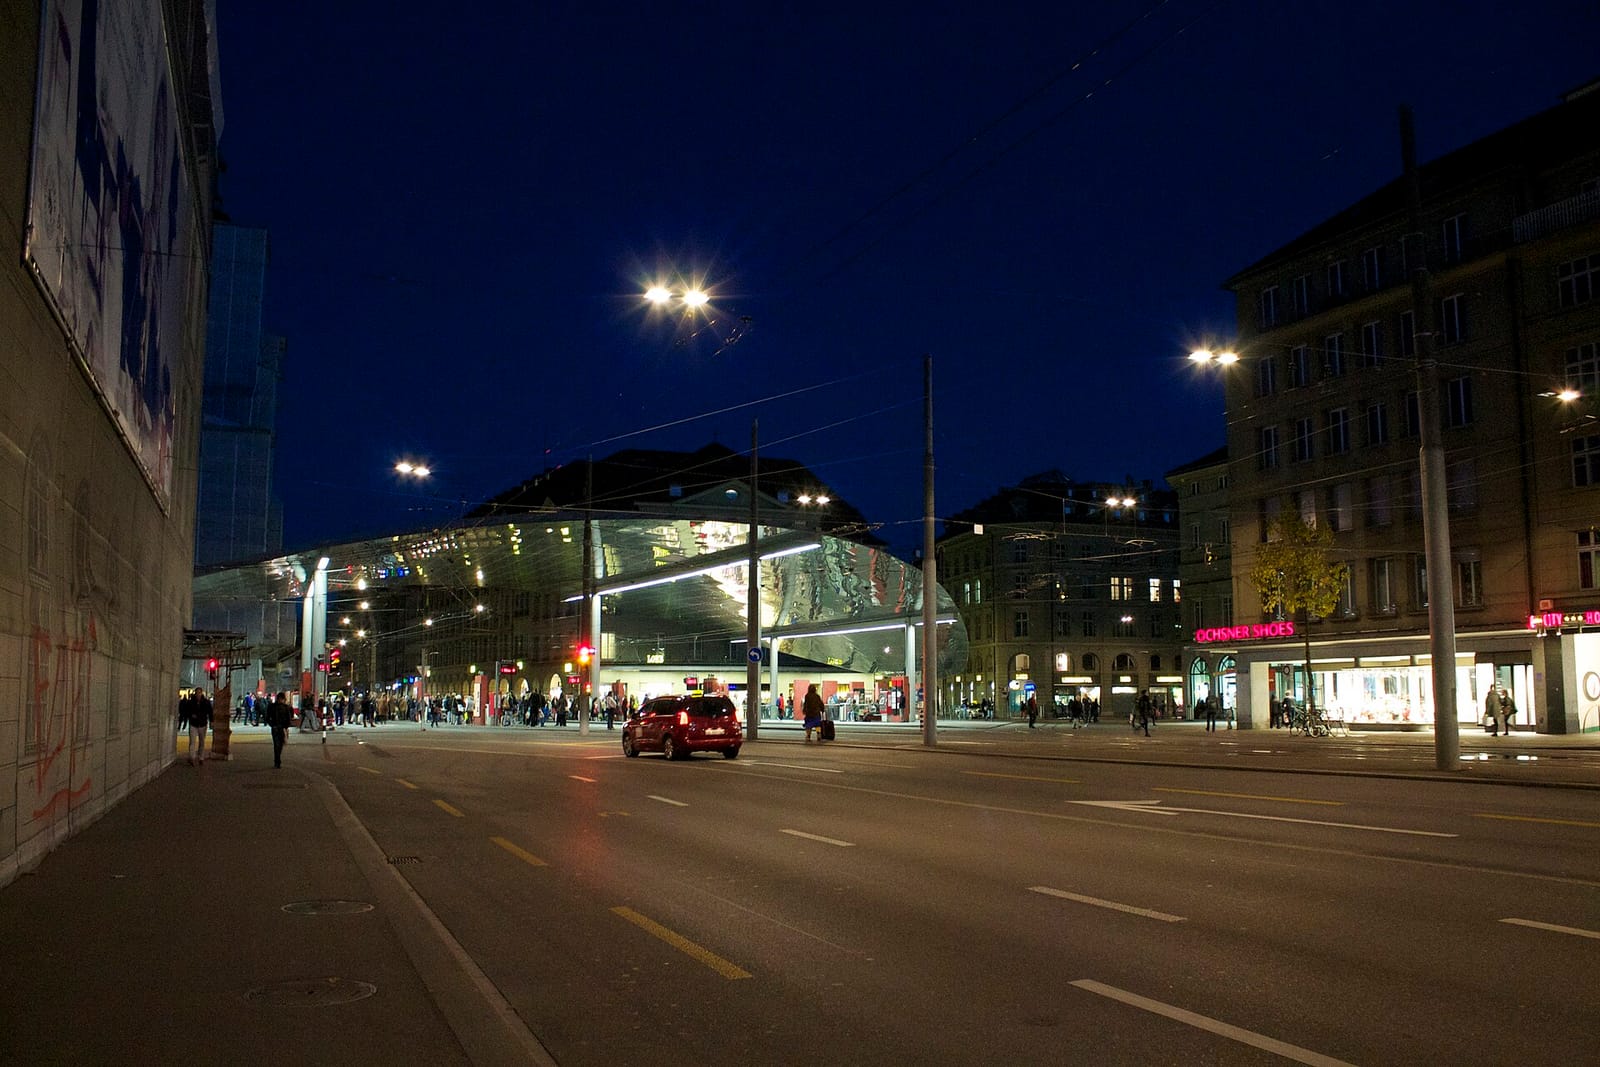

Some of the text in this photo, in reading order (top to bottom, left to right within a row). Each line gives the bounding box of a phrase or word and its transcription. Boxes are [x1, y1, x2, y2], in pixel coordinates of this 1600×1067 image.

[1543, 613, 1562, 626] CITY
[1196, 622, 1294, 642] OCHSNER SHOES
